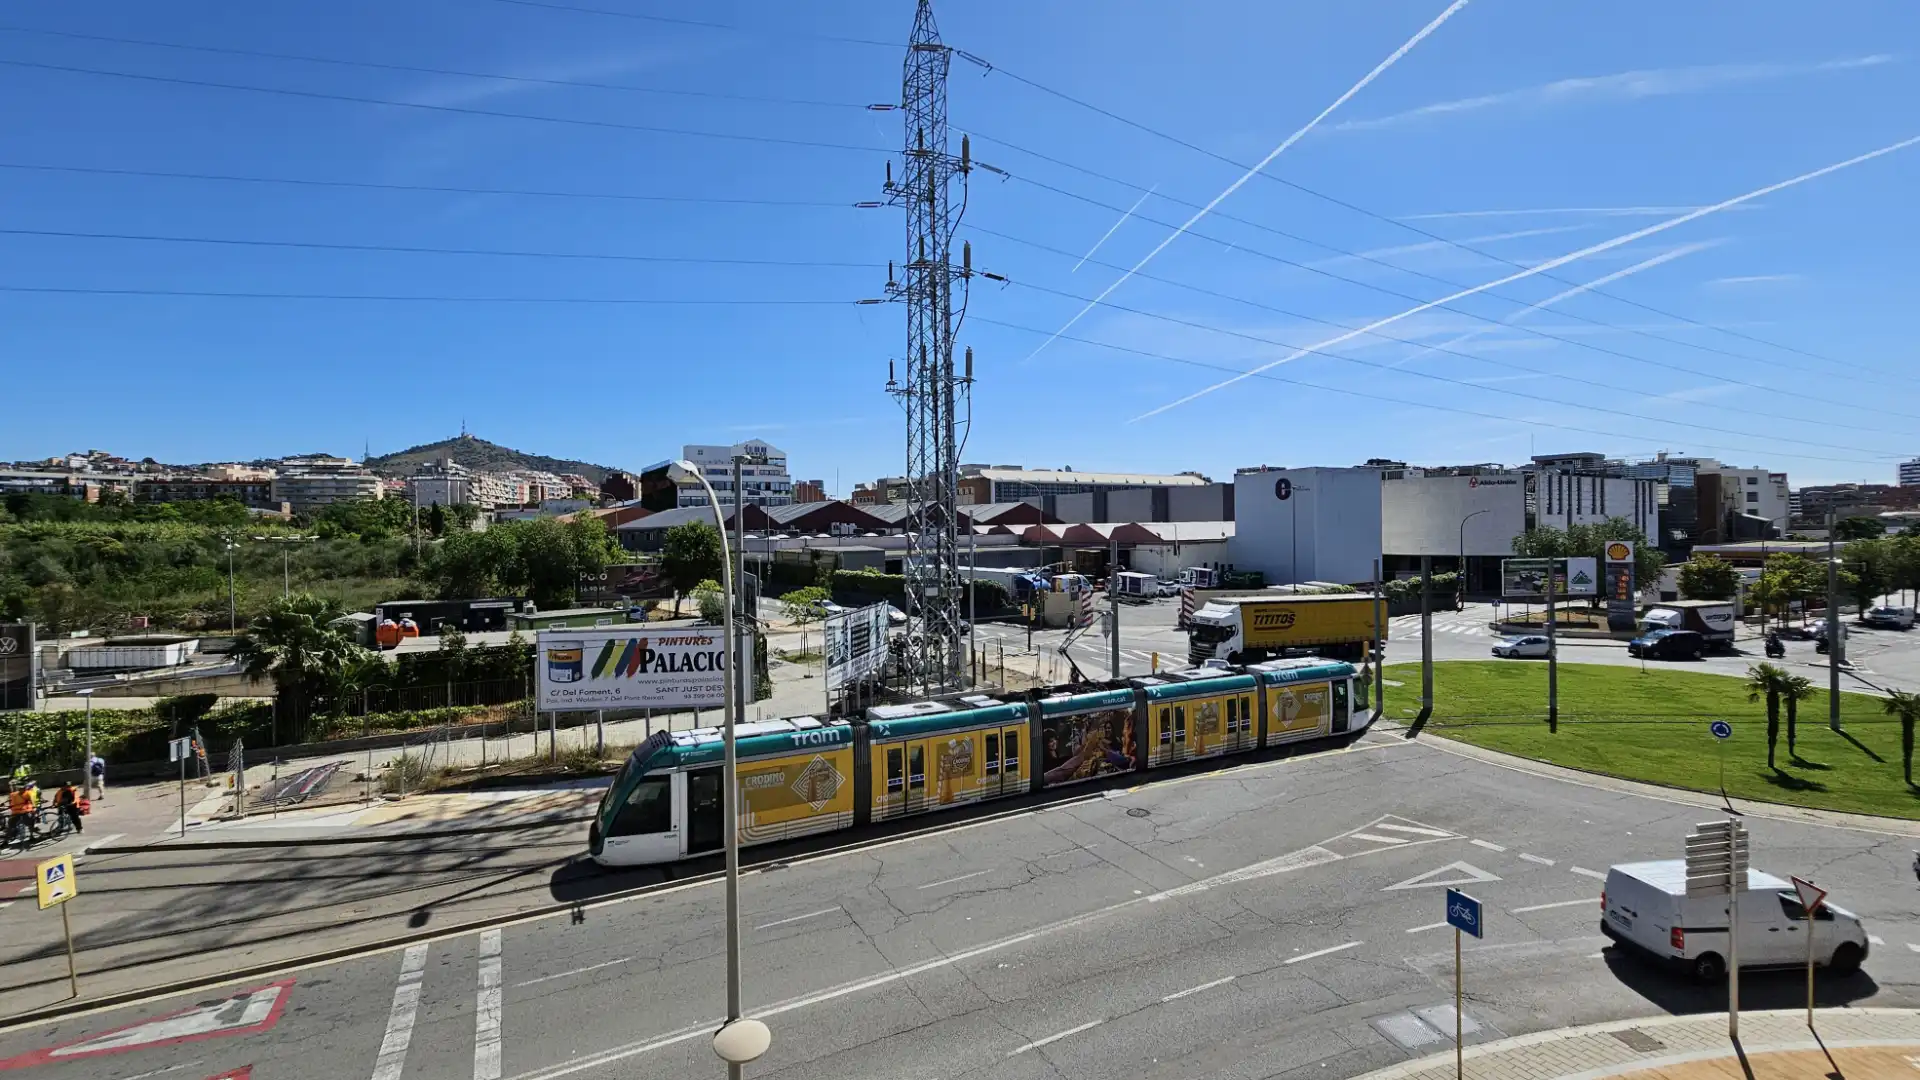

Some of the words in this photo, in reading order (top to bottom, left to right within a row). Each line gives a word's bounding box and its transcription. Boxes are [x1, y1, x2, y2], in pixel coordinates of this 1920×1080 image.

[1254, 613, 1297, 625] TITITOS
[658, 636, 714, 646] PINTURES
[639, 648, 736, 673] PALACIO
[1102, 696, 1126, 704] tram.cat
